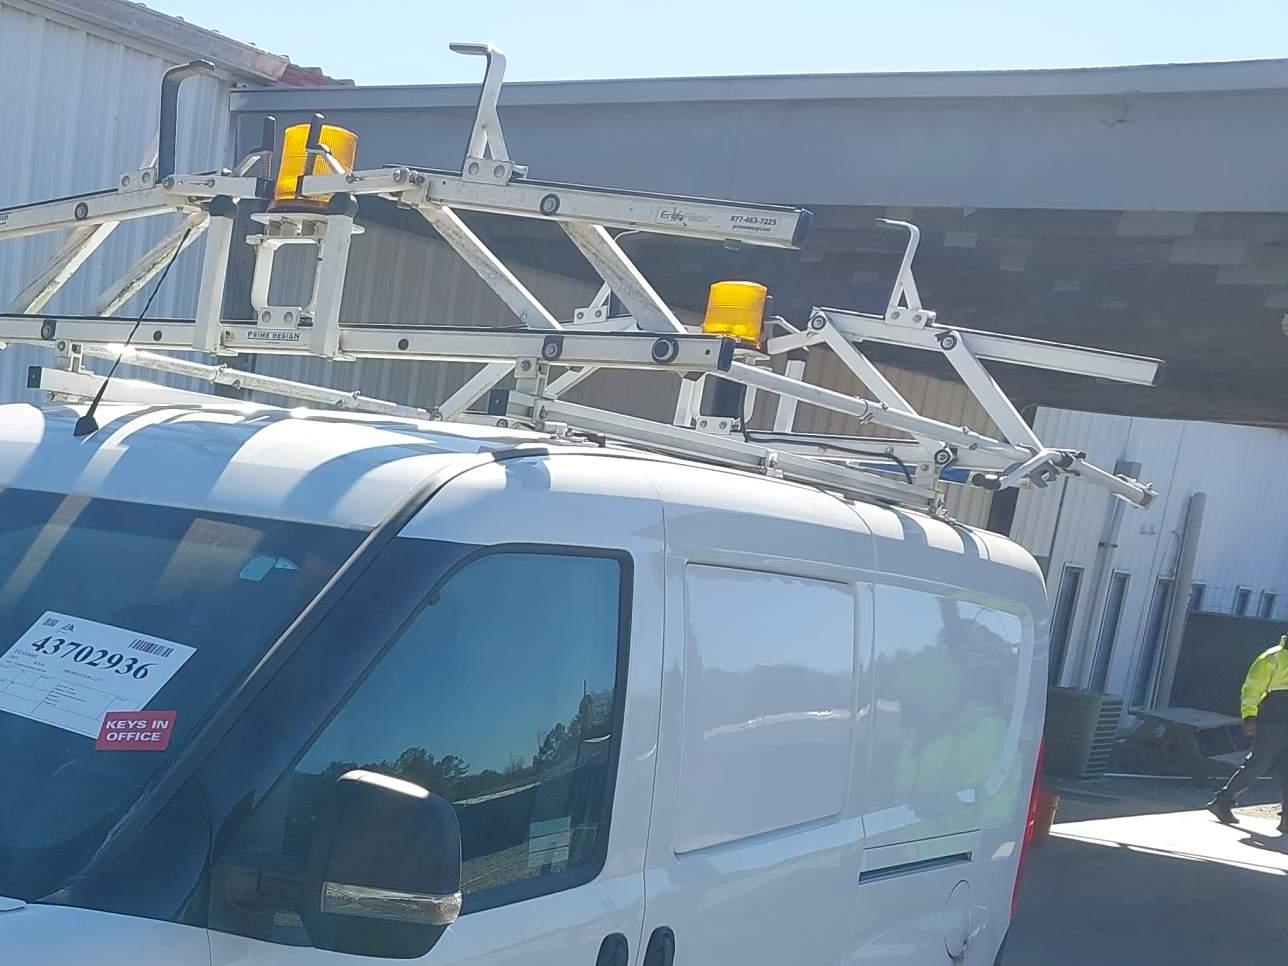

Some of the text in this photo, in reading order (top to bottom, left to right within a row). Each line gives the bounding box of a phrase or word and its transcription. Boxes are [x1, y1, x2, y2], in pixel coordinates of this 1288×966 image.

[31, 635, 158, 680] 43702936
[105, 720, 169, 729] KEYS IN
[106, 732, 161, 742] OFFICE
